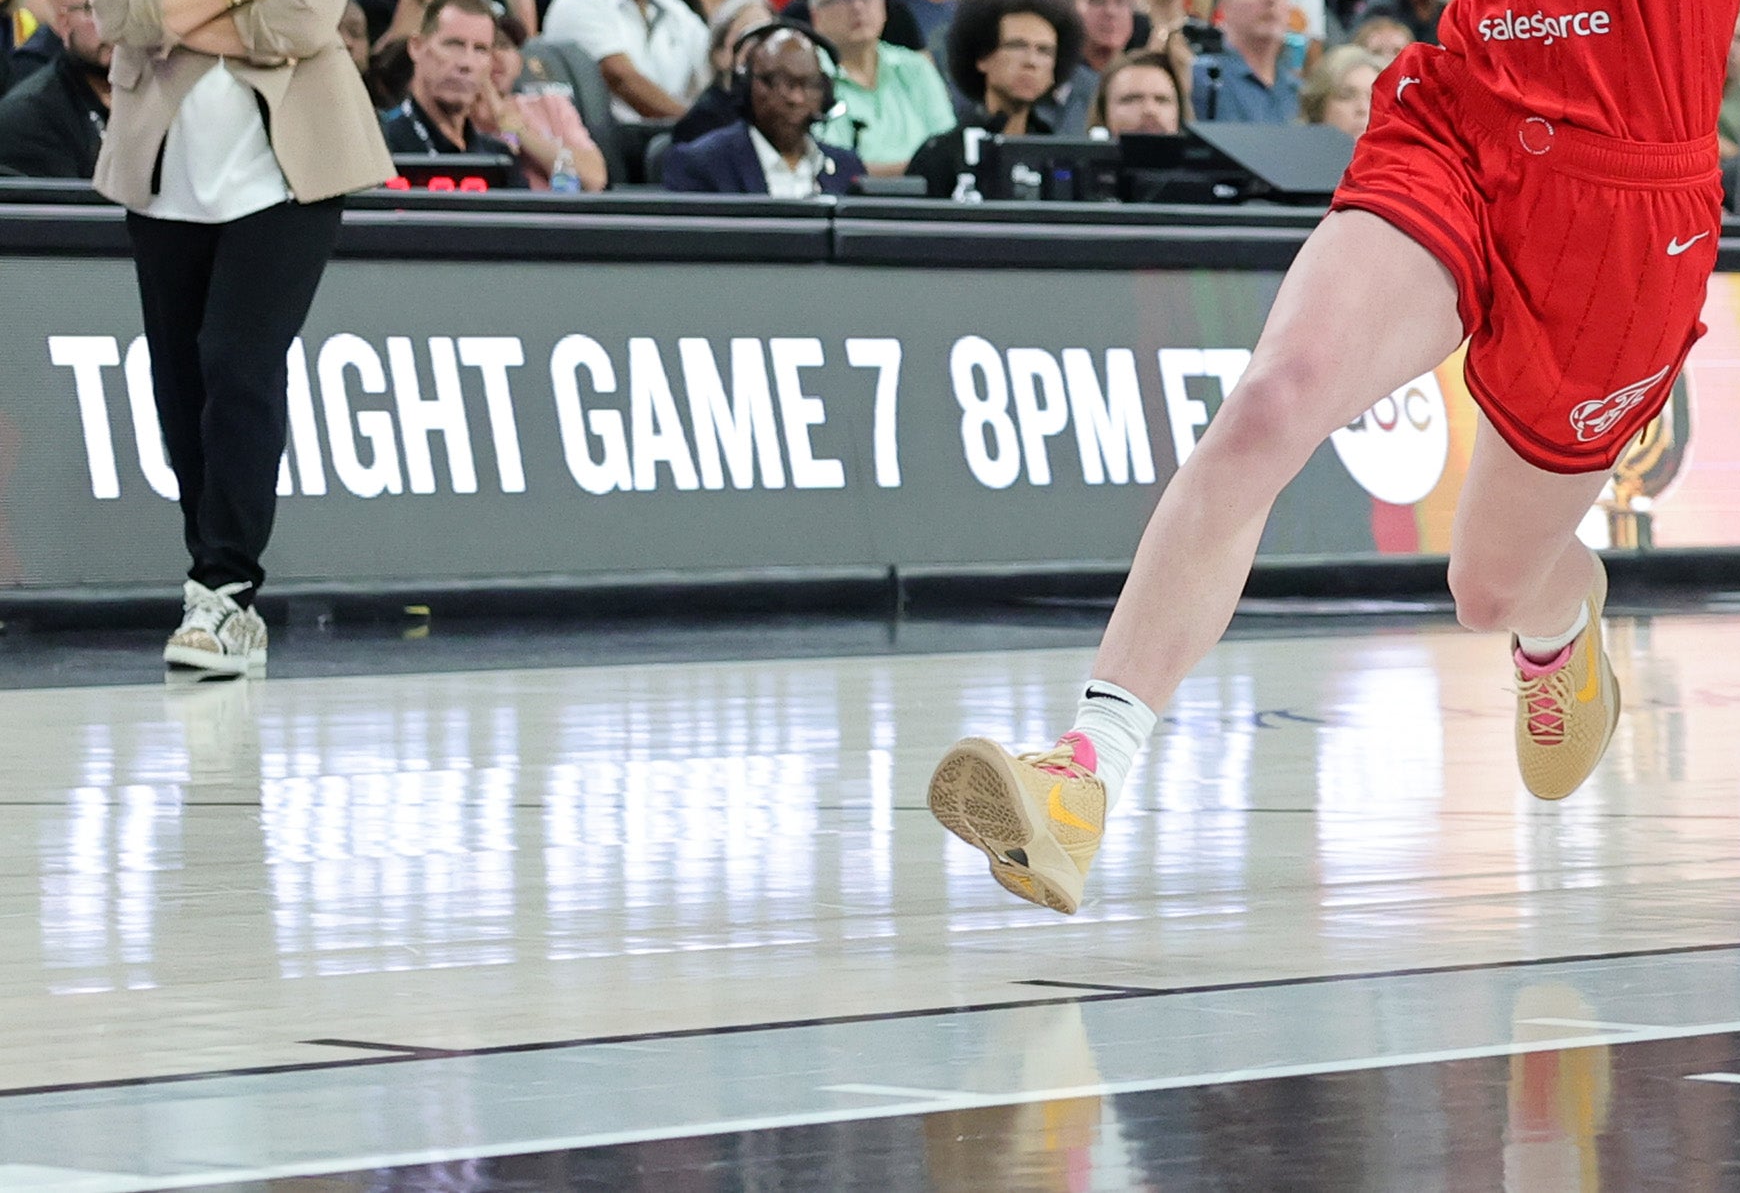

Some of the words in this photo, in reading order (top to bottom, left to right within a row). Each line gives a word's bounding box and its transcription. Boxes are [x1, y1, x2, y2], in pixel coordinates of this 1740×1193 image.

[1477, 9, 1611, 46] salesorce
[47, 333, 527, 502] TIGHT
[550, 333, 846, 495] GAME
[847, 337, 903, 489] 7
[950, 335, 1156, 490] 8PM
